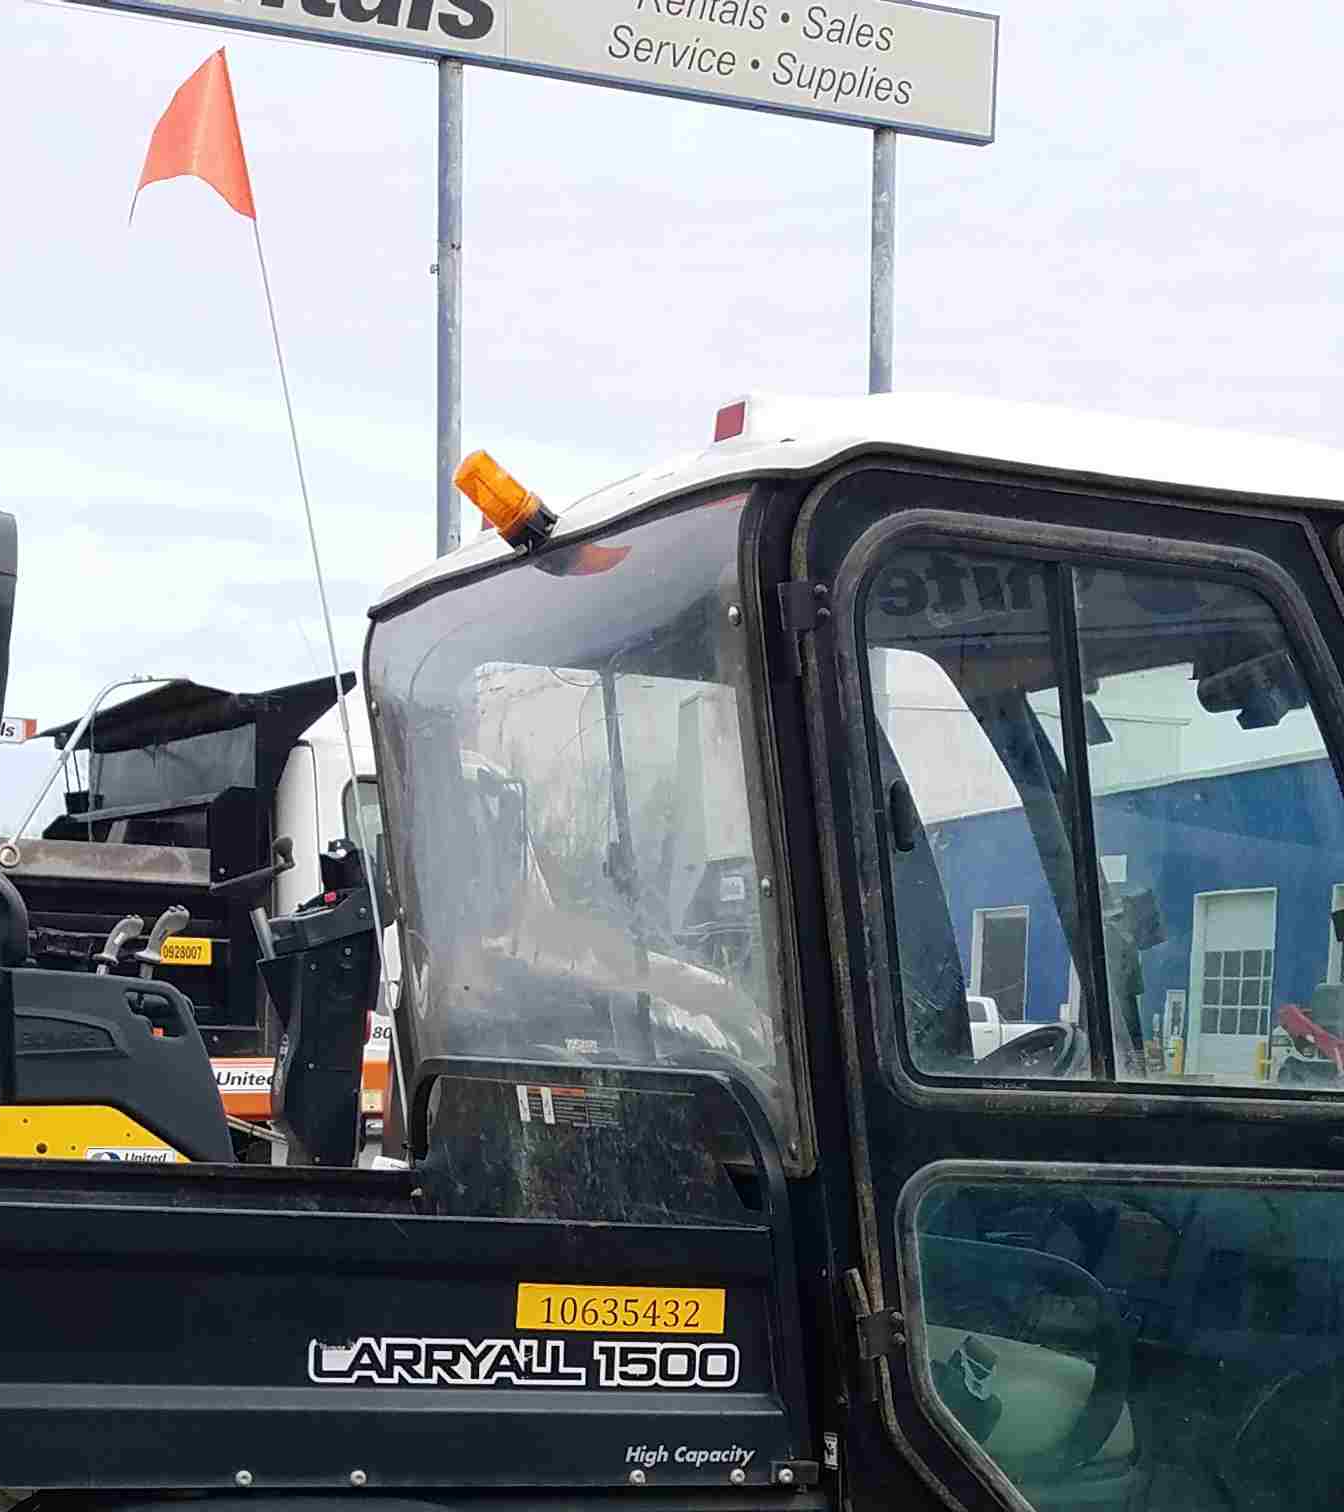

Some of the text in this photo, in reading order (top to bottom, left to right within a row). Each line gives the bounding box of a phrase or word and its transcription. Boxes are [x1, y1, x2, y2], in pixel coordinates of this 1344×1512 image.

[802, 7, 894, 51] Sales
[608, 25, 913, 105] Service Supplies
[540, 1296, 701, 1328] 10635432
[593, 1341, 740, 1388] 1500
[624, 1444, 756, 1468] High Capacity
